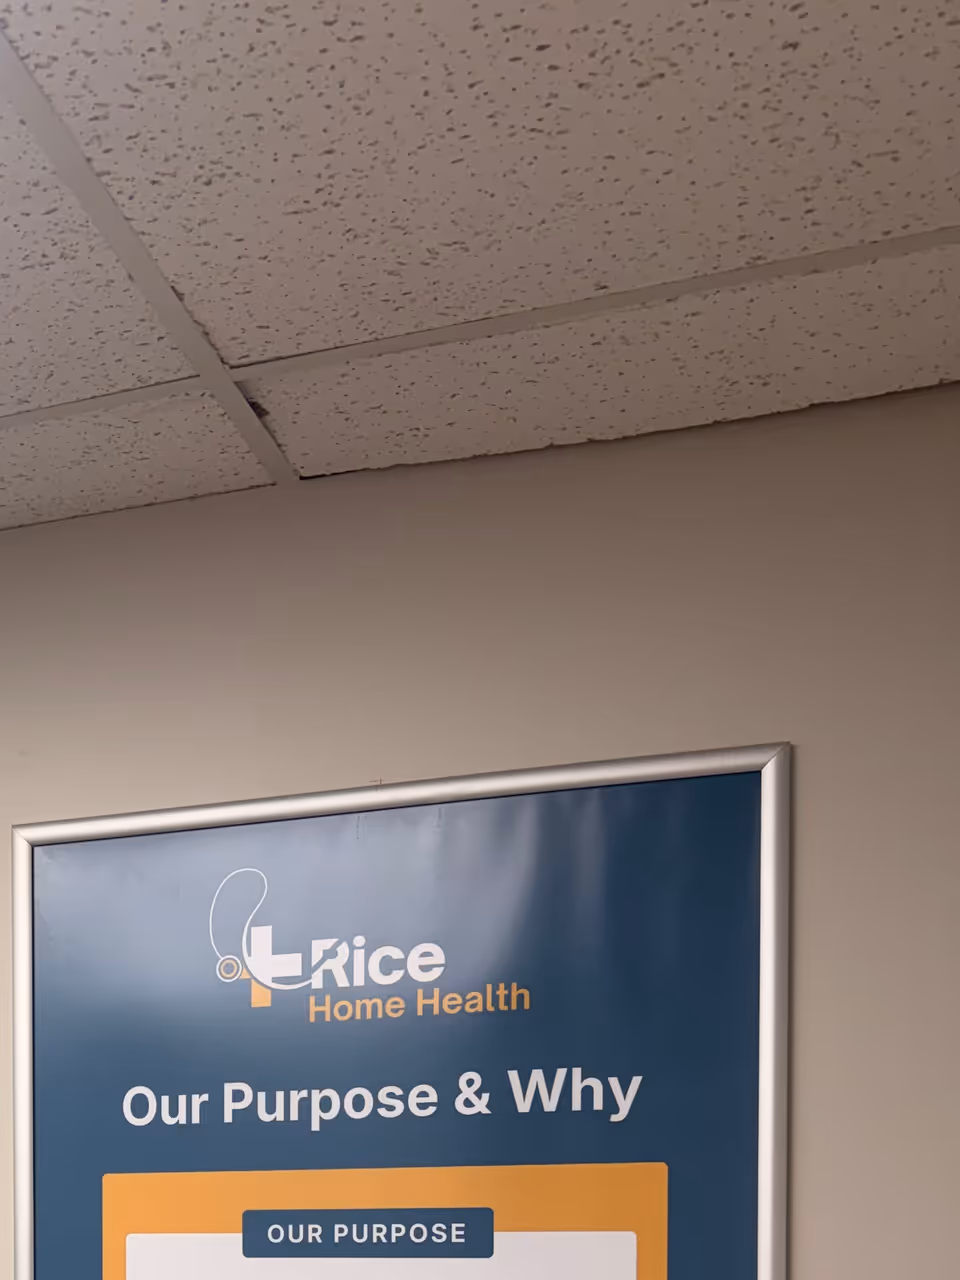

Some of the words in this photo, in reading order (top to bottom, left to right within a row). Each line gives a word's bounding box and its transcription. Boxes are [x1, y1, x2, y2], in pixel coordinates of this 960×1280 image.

[310, 936, 445, 988] Rice
[309, 995, 404, 1022] Home
[416, 983, 530, 1015] Health
[122, 1086, 209, 1126] Our
[223, 1082, 438, 1130] Purpose
[454, 1071, 491, 1115] &
[507, 1068, 642, 1121] Why
[267, 1224, 322, 1243] OUR
[334, 1223, 465, 1243] PURPOSE
